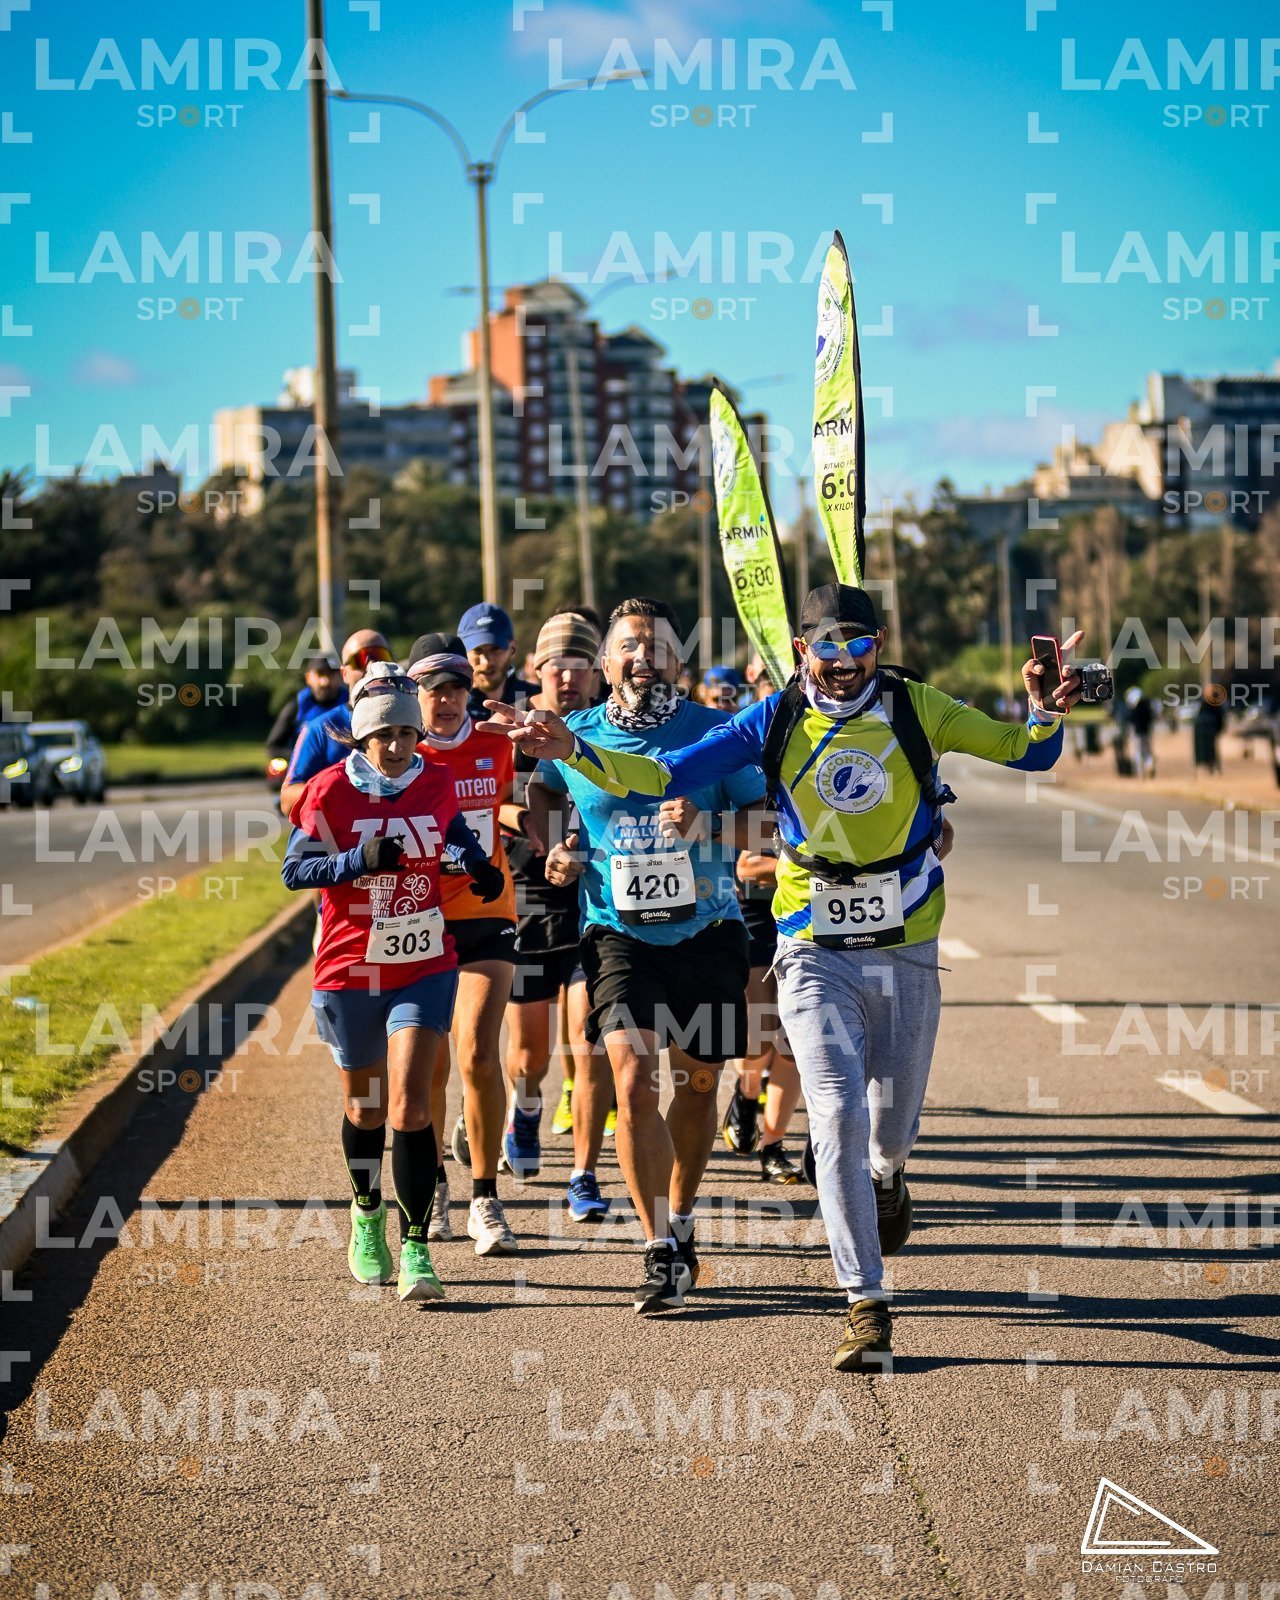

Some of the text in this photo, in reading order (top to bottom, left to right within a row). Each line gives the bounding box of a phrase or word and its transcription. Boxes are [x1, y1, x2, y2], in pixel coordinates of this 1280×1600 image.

[826, 503, 833, 512] X
[734, 565, 774, 589] 6:00
[821, 755, 873, 798] HALCONES
[351, 815, 443, 859] TAF
[620, 827, 664, 838] MALVI
[370, 889, 394, 900] SWIM
[626, 873, 680, 901] 420
[371, 910, 390, 919] RUN
[372, 900, 392, 910] BIKE
[828, 896, 886, 925] 953
[384, 929, 431, 957] 303
